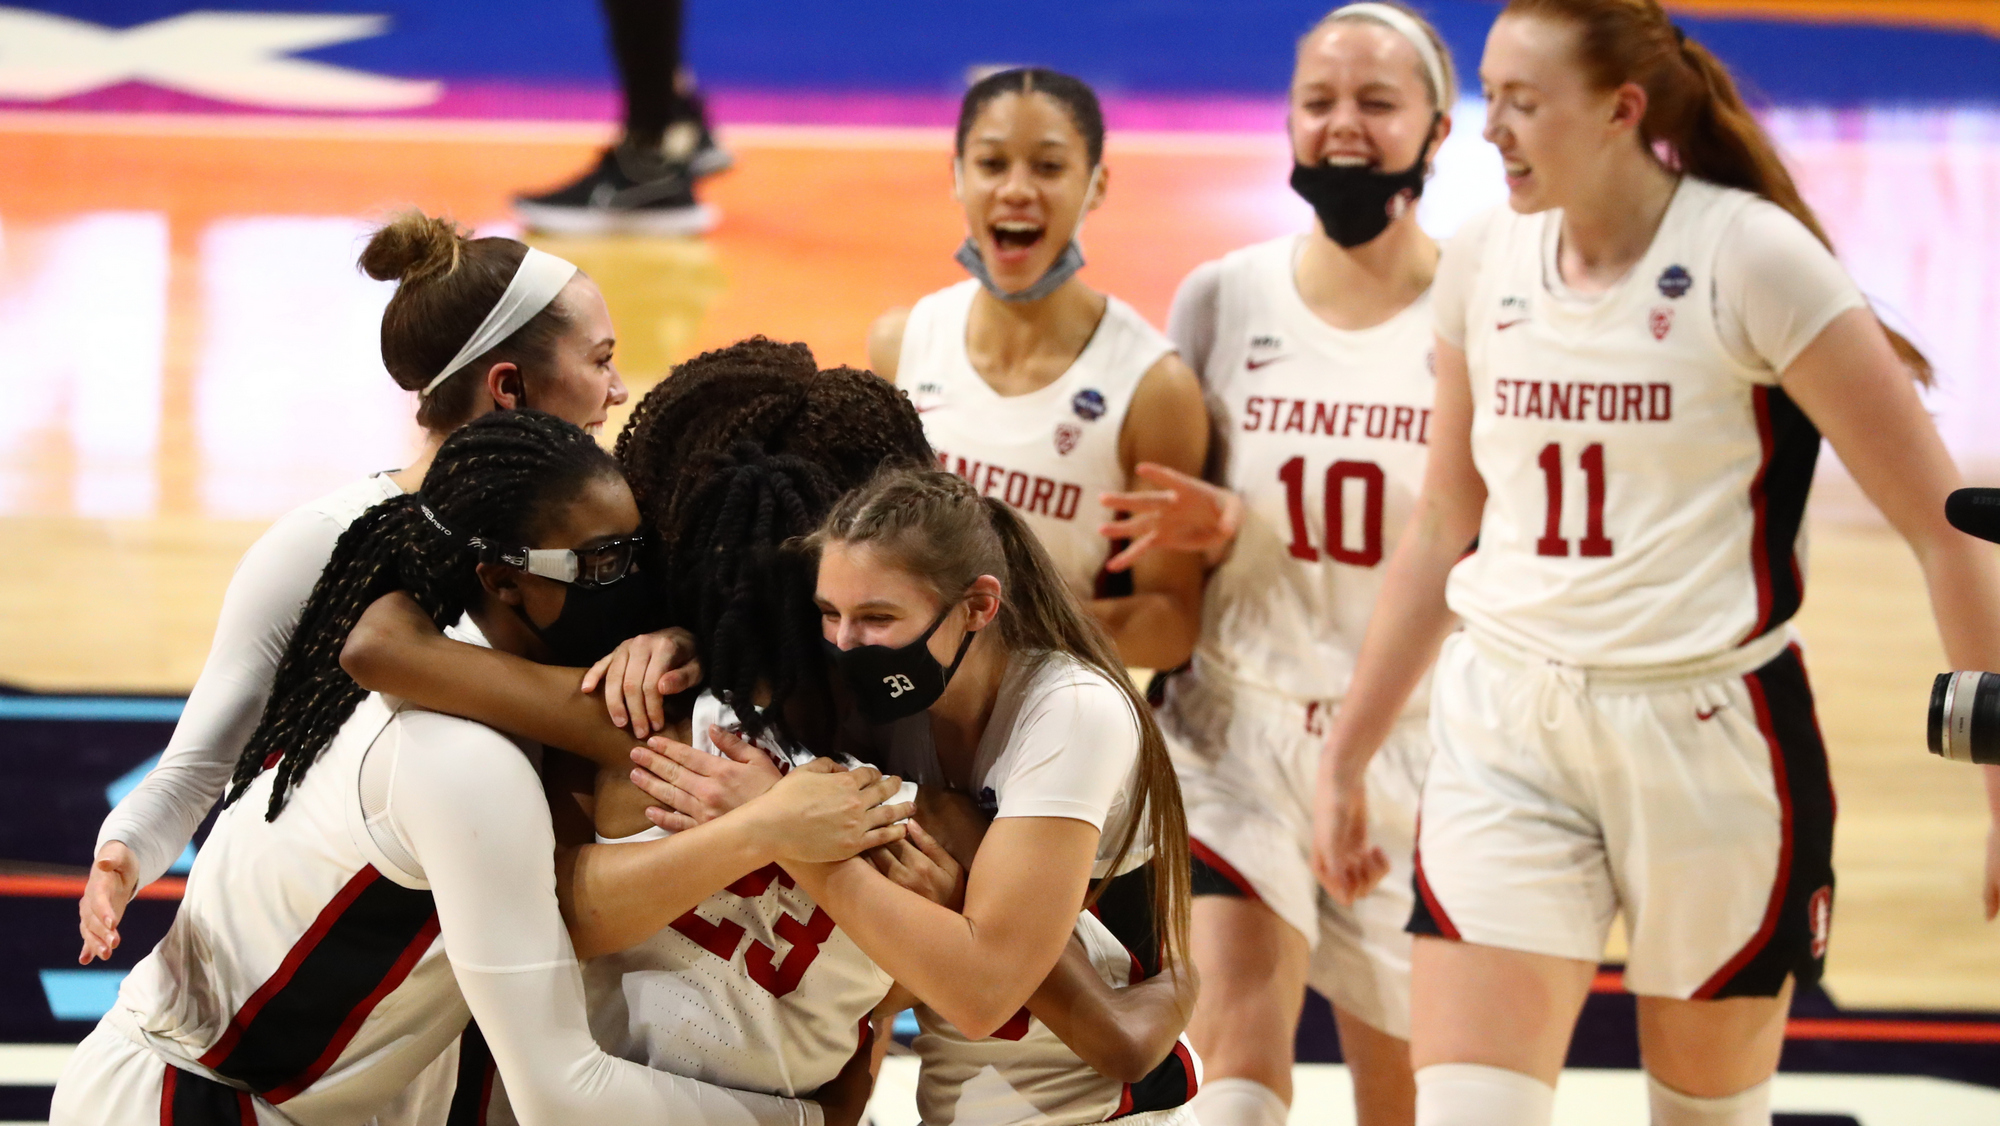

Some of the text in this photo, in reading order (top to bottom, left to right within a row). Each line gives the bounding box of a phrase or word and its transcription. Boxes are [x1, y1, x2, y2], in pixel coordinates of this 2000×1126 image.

[1494, 378, 1672, 422] STANFORD
[937, 452, 1083, 521] NFORD
[1278, 455, 1385, 568] 10
[1536, 441, 1614, 558] 11
[883, 673, 916, 699] 33
[668, 861, 836, 999] 23
